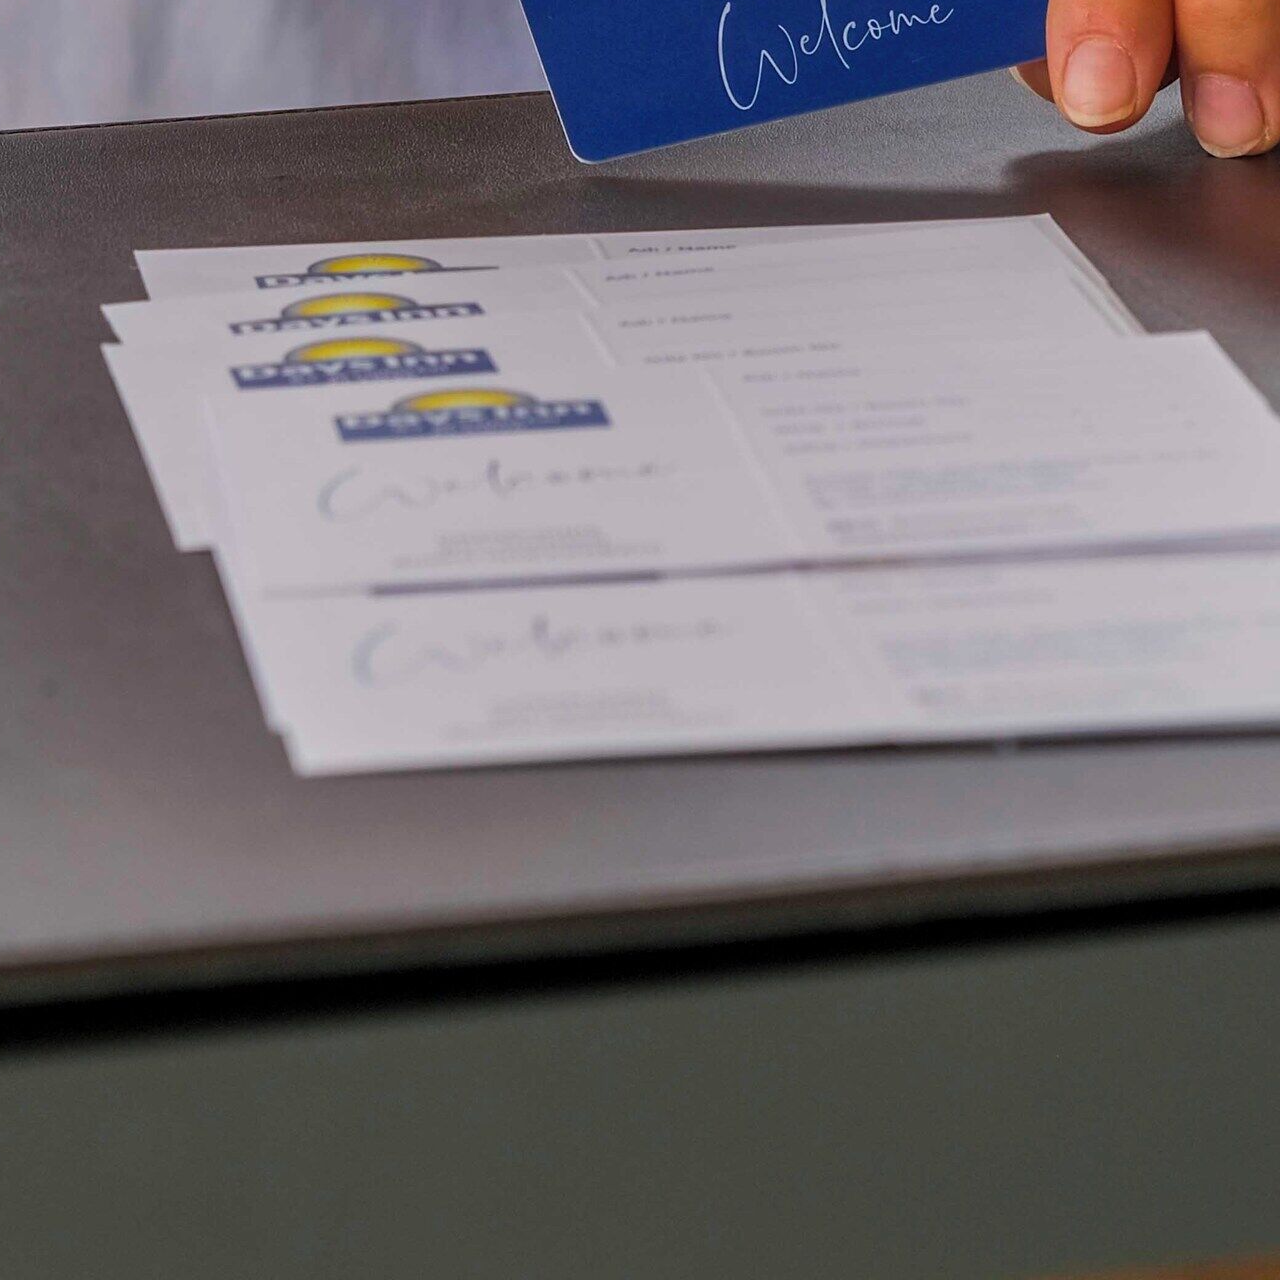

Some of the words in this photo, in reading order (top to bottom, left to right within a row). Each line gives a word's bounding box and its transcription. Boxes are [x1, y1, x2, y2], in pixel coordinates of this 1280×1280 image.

[237, 355, 374, 378] Days
[382, 350, 477, 368] Inn
[341, 408, 483, 430] Days
[493, 403, 592, 421] Inn
